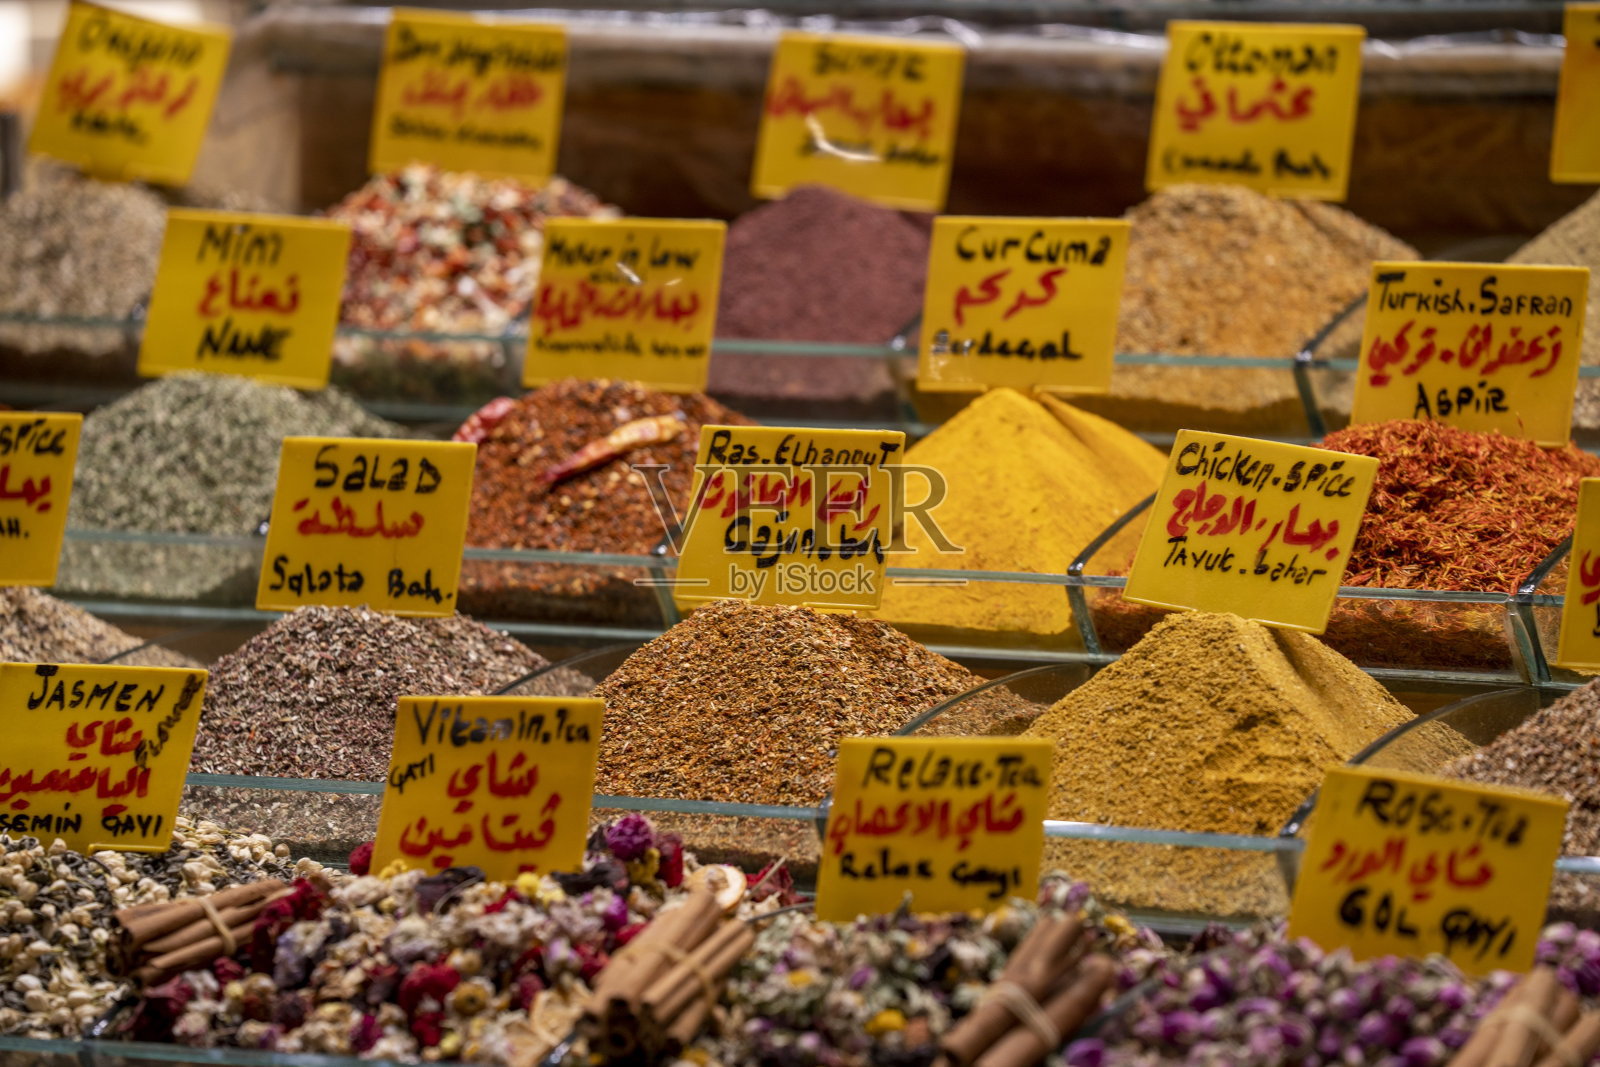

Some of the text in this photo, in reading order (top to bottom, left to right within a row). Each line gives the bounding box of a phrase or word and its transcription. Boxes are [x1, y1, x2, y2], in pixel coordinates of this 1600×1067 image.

[951, 264, 1070, 332] كركم
[25, 664, 166, 714] JASMEN
[445, 750, 541, 816] شاي
